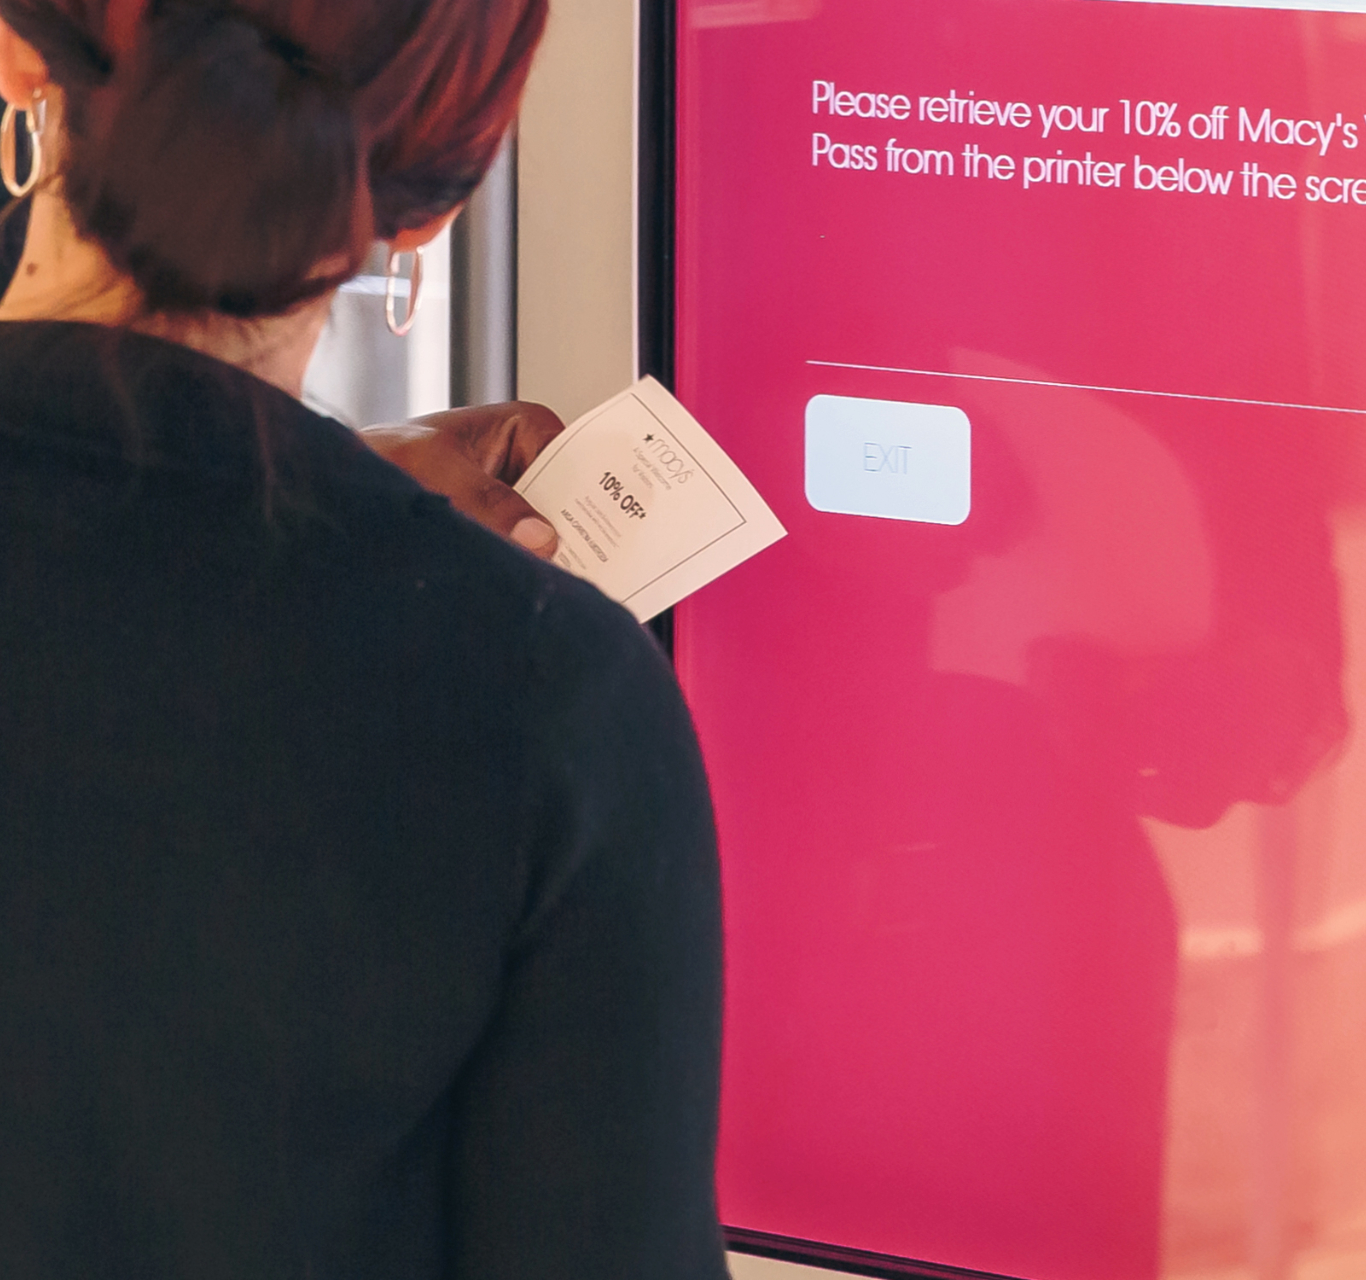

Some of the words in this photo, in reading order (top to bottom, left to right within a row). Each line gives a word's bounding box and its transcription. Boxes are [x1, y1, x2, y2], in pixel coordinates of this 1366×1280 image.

[811, 79, 912, 121] Please
[918, 89, 1033, 129] retrieve
[1036, 104, 1111, 138] your
[1119, 99, 1182, 138] 10%
[1188, 104, 1232, 141] off
[1237, 107, 1359, 157] Macy's
[812, 131, 879, 172] Pass
[884, 137, 955, 177] from
[961, 142, 1017, 181] the
[1022, 148, 1127, 190] printer
[1133, 153, 1235, 196] below
[1239, 161, 1298, 201] the
[863, 441, 913, 475] EXIT
[598, 471, 624, 501] 10%
